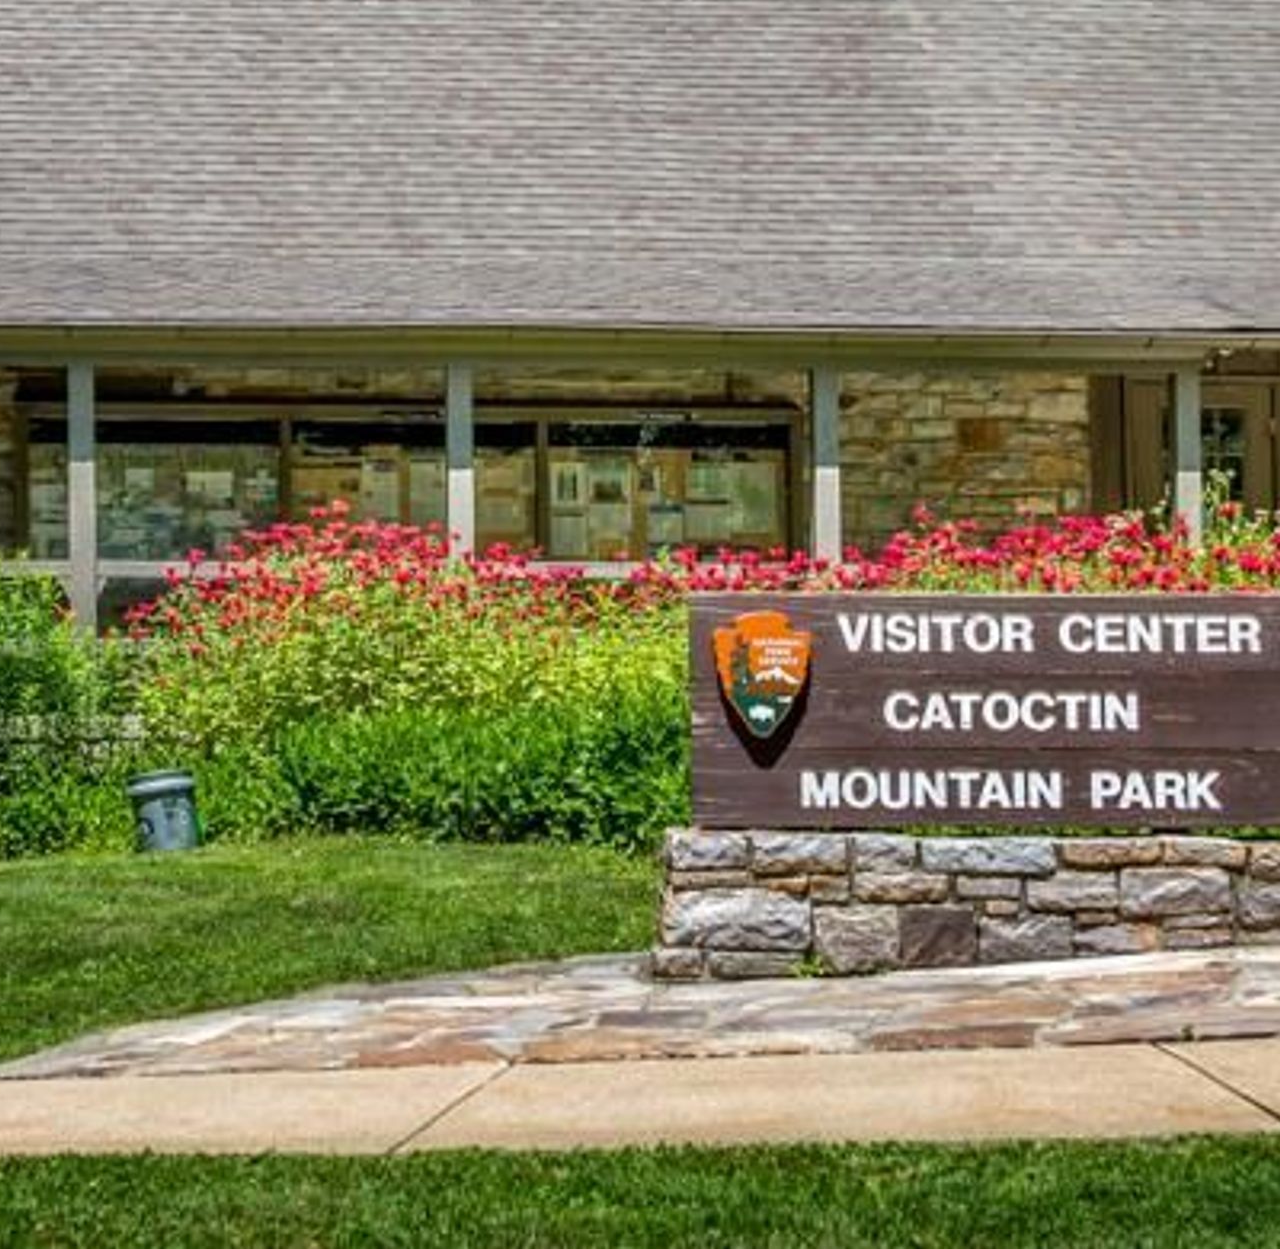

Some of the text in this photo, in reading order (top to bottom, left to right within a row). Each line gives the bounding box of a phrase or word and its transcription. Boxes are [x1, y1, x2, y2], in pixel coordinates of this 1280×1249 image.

[836, 612, 1263, 654] VISITOR CENTER
[882, 690, 1140, 732] CATOCTIN
[799, 769, 1222, 810] MOUNTAIN PARK
